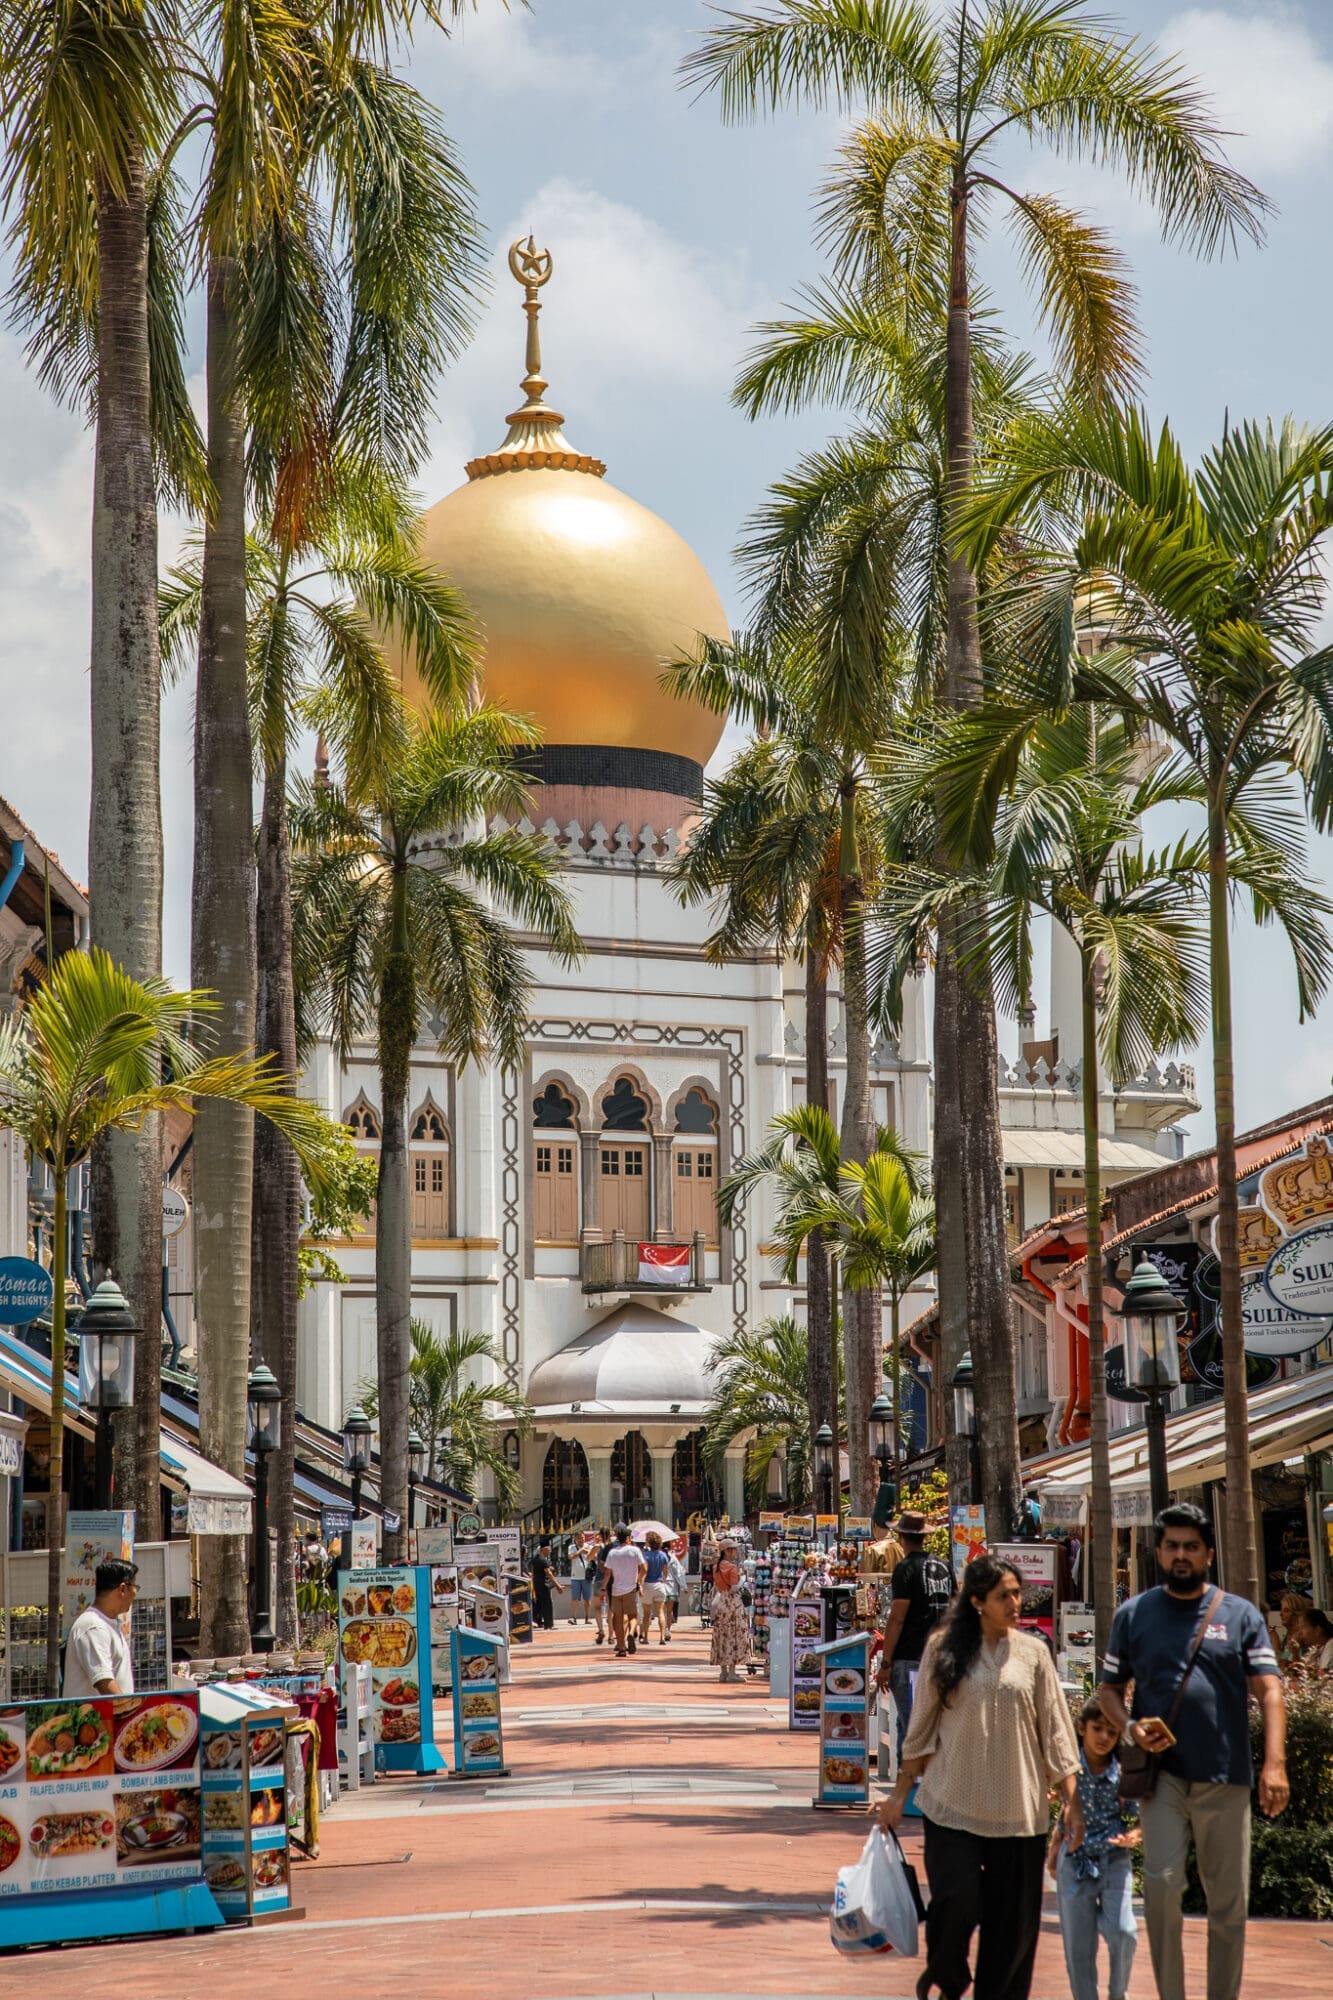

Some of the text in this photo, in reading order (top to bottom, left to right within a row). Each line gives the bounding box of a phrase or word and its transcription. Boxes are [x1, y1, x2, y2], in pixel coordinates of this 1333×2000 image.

[1283, 1287, 1320, 1300] Traditional
[12, 1295, 48, 1306] DELIGHTS
[1266, 1328, 1290, 1336] Turkish
[1291, 1326, 1325, 1335] Restaurant
[121, 1776, 149, 1788] BOMBAY
[150, 1774, 168, 1786] LAMB
[169, 1772, 195, 1784] BIRYANI
[0, 1787, 18, 1798] AB
[30, 1780, 109, 1796] FALAFEL OR FALAFEL WRAP
[30, 1872, 116, 1891] MIXED KEBAB PLATTER
[0, 1884, 22, 1894] CIAL
